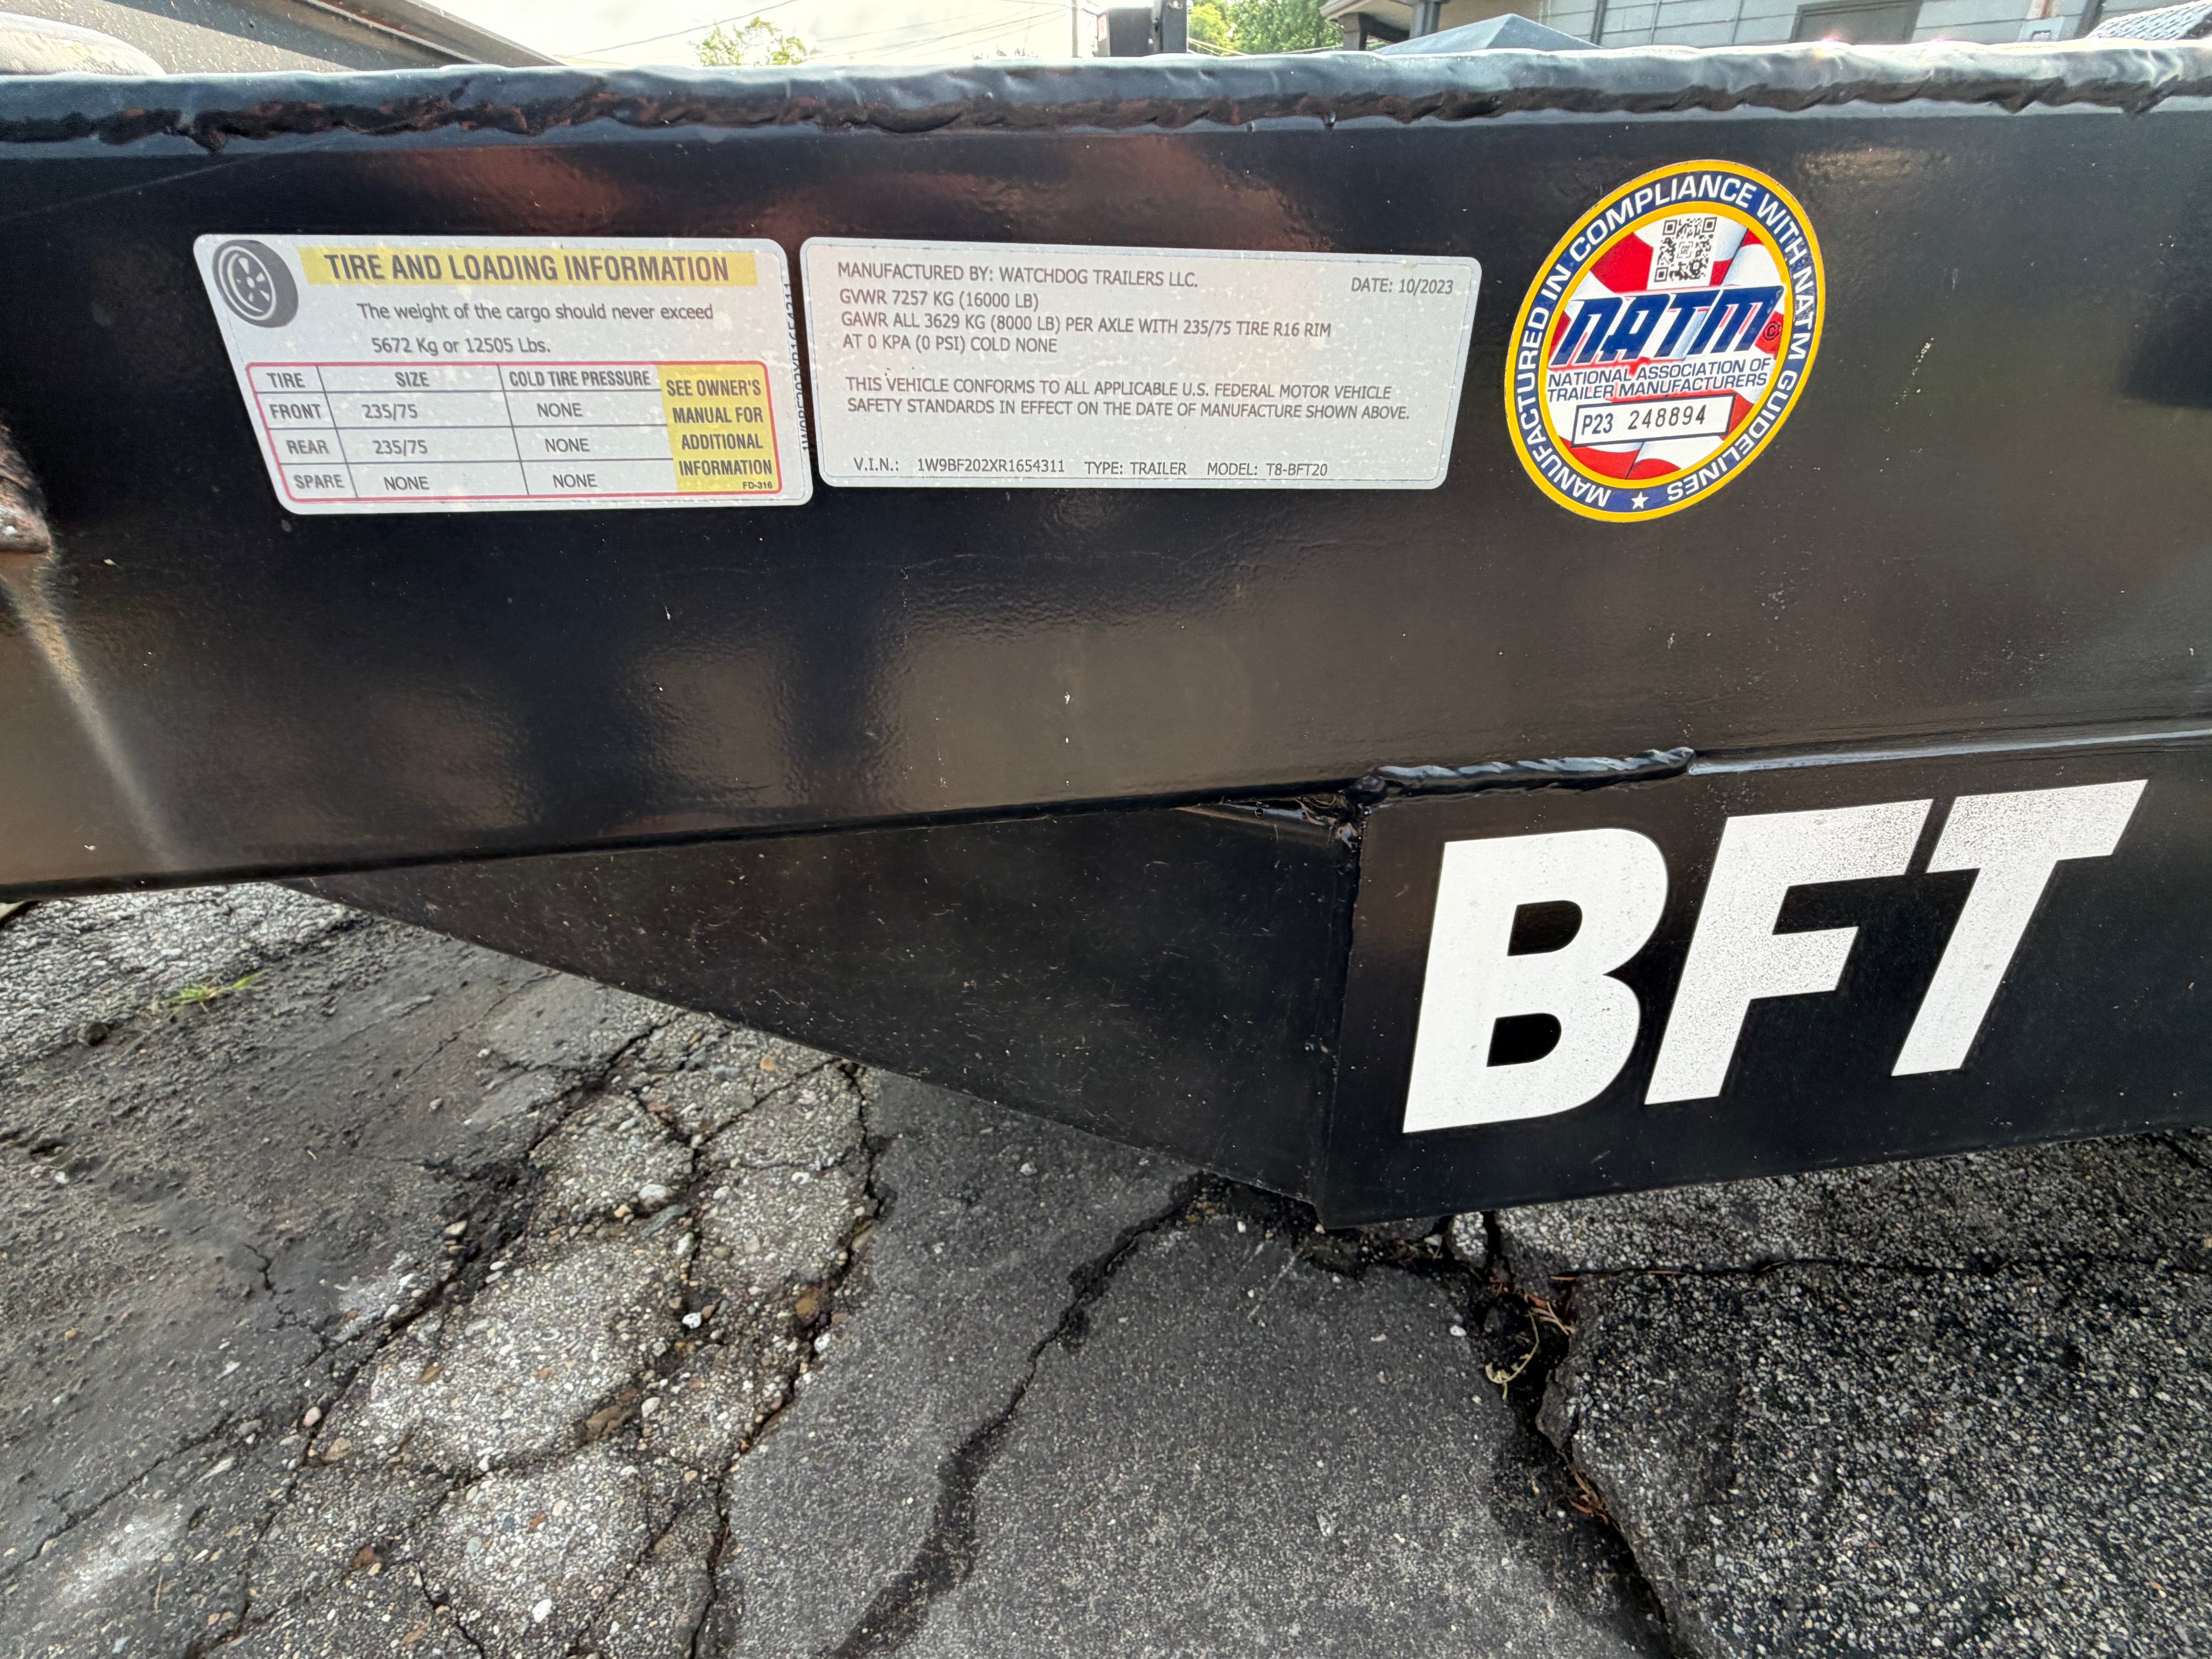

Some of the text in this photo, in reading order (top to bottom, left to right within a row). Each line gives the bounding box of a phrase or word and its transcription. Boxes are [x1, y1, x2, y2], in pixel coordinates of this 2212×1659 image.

[324, 254, 728, 281] TIRE AND LOADING INFORMATION
[838, 262, 1197, 287] MANUFACTURED BY: WATCHDOG TRAILERS LLC.
[1352, 277, 1453, 296] DATE: 10/2023
[840, 289, 1038, 312] GVWR 7257 KG (16000 LB)
[356, 303, 713, 323] The weight of the cargo should never exceed
[842, 311, 1331, 337] GAWR ALL 3629 KG (8000 LB) PER AXLE WITH 235/75 TIRE R16 RIM
[1550, 285, 1784, 365] NATM
[371, 337, 550, 356] 5672 Kg or 12505 Lbs.
[843, 334, 1057, 354] AT 0 KPA (0 PSI) COLD NONE
[1517, 175, 1815, 507] MANUFACTURED IN COMPLIANCE WITH NATM GUIDELINES
[266, 373, 305, 388] TIRE
[395, 372, 430, 387] SIZE
[509, 371, 651, 386] COLD TIRE PRESSURE
[1548, 358, 1771, 387] NATIONAL ASSOCIATION OF
[666, 380, 761, 397] SEE OWNER'S
[845, 377, 1392, 399] THIS VEHICLE CONFORMS TO ALL APPLICABLE U.S. FEDERAL MOTOR VEHICLE
[1547, 373, 1767, 402] TRAILER MANUFACTURERS
[269, 404, 321, 419] FRONT
[362, 404, 418, 421] 235/75
[537, 403, 583, 417] NONE
[672, 407, 763, 423] MANUAL FOR
[848, 398, 1409, 419] SAFETY STANDARDS IN EFFECT ON THE DATE OF MANUFACTURE SHOWN ABOVE.
[1582, 405, 1706, 435] P23 248894
[286, 440, 329, 454] REAR
[373, 440, 428, 457] 235/75
[545, 438, 590, 452] NONE
[682, 434, 763, 450] ADDITIONAL
[679, 460, 772, 476] INFORMATION
[854, 457, 1327, 476] V.I.N.: 1W9BF202XR1654311 TYPE: TRAILER MODEL: T8-BFT20
[294, 474, 344, 489] SPARE
[384, 476, 429, 490] NONE
[553, 474, 597, 488] NONE
[1403, 780, 2148, 1133] BFT
